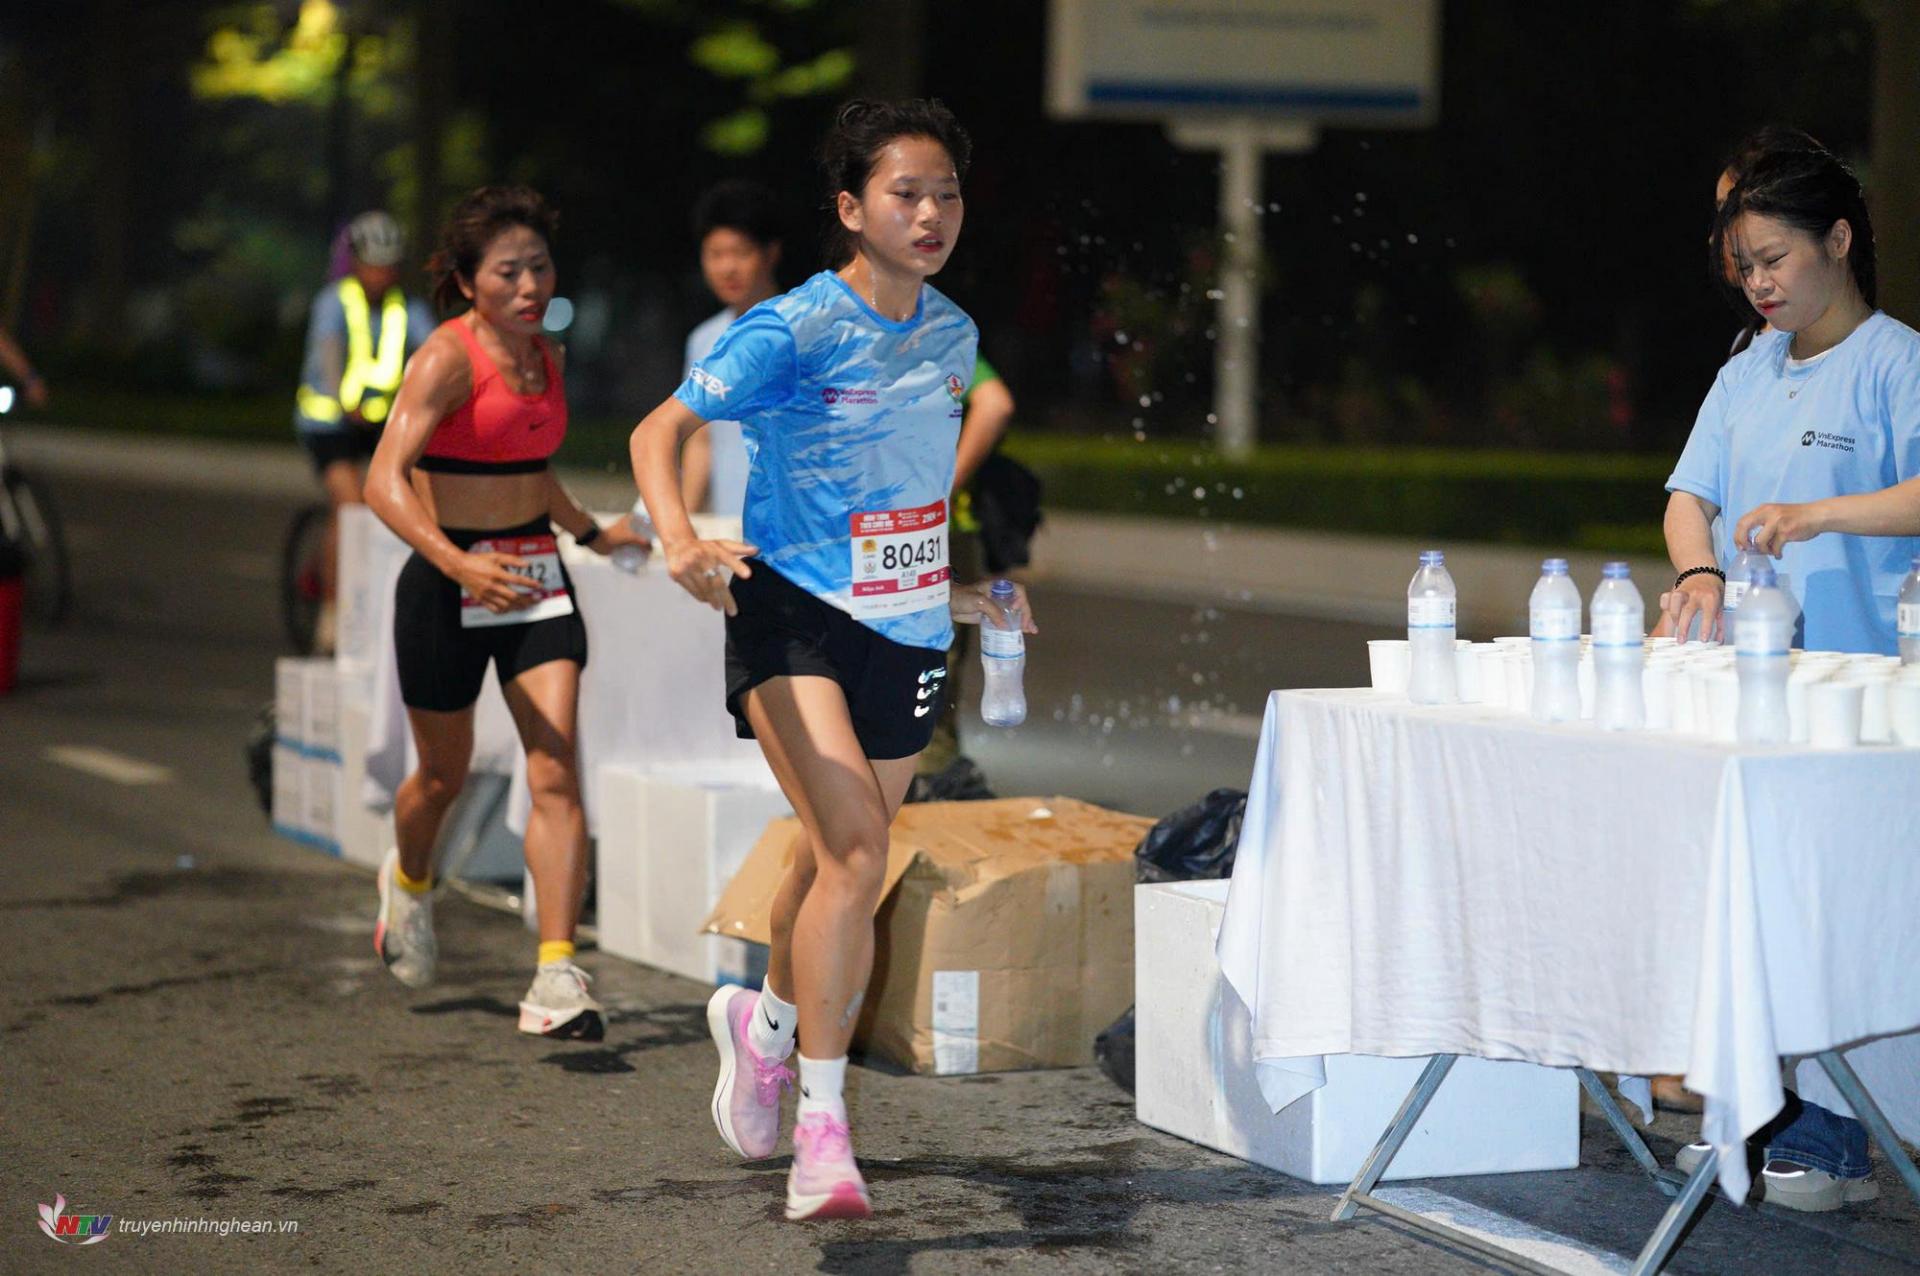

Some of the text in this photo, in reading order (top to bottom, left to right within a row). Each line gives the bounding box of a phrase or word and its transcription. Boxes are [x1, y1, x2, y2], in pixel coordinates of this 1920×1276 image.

[1818, 432, 1855, 444] VnExpress
[1817, 440, 1855, 452] Marathon
[882, 535, 941, 570] 80431
